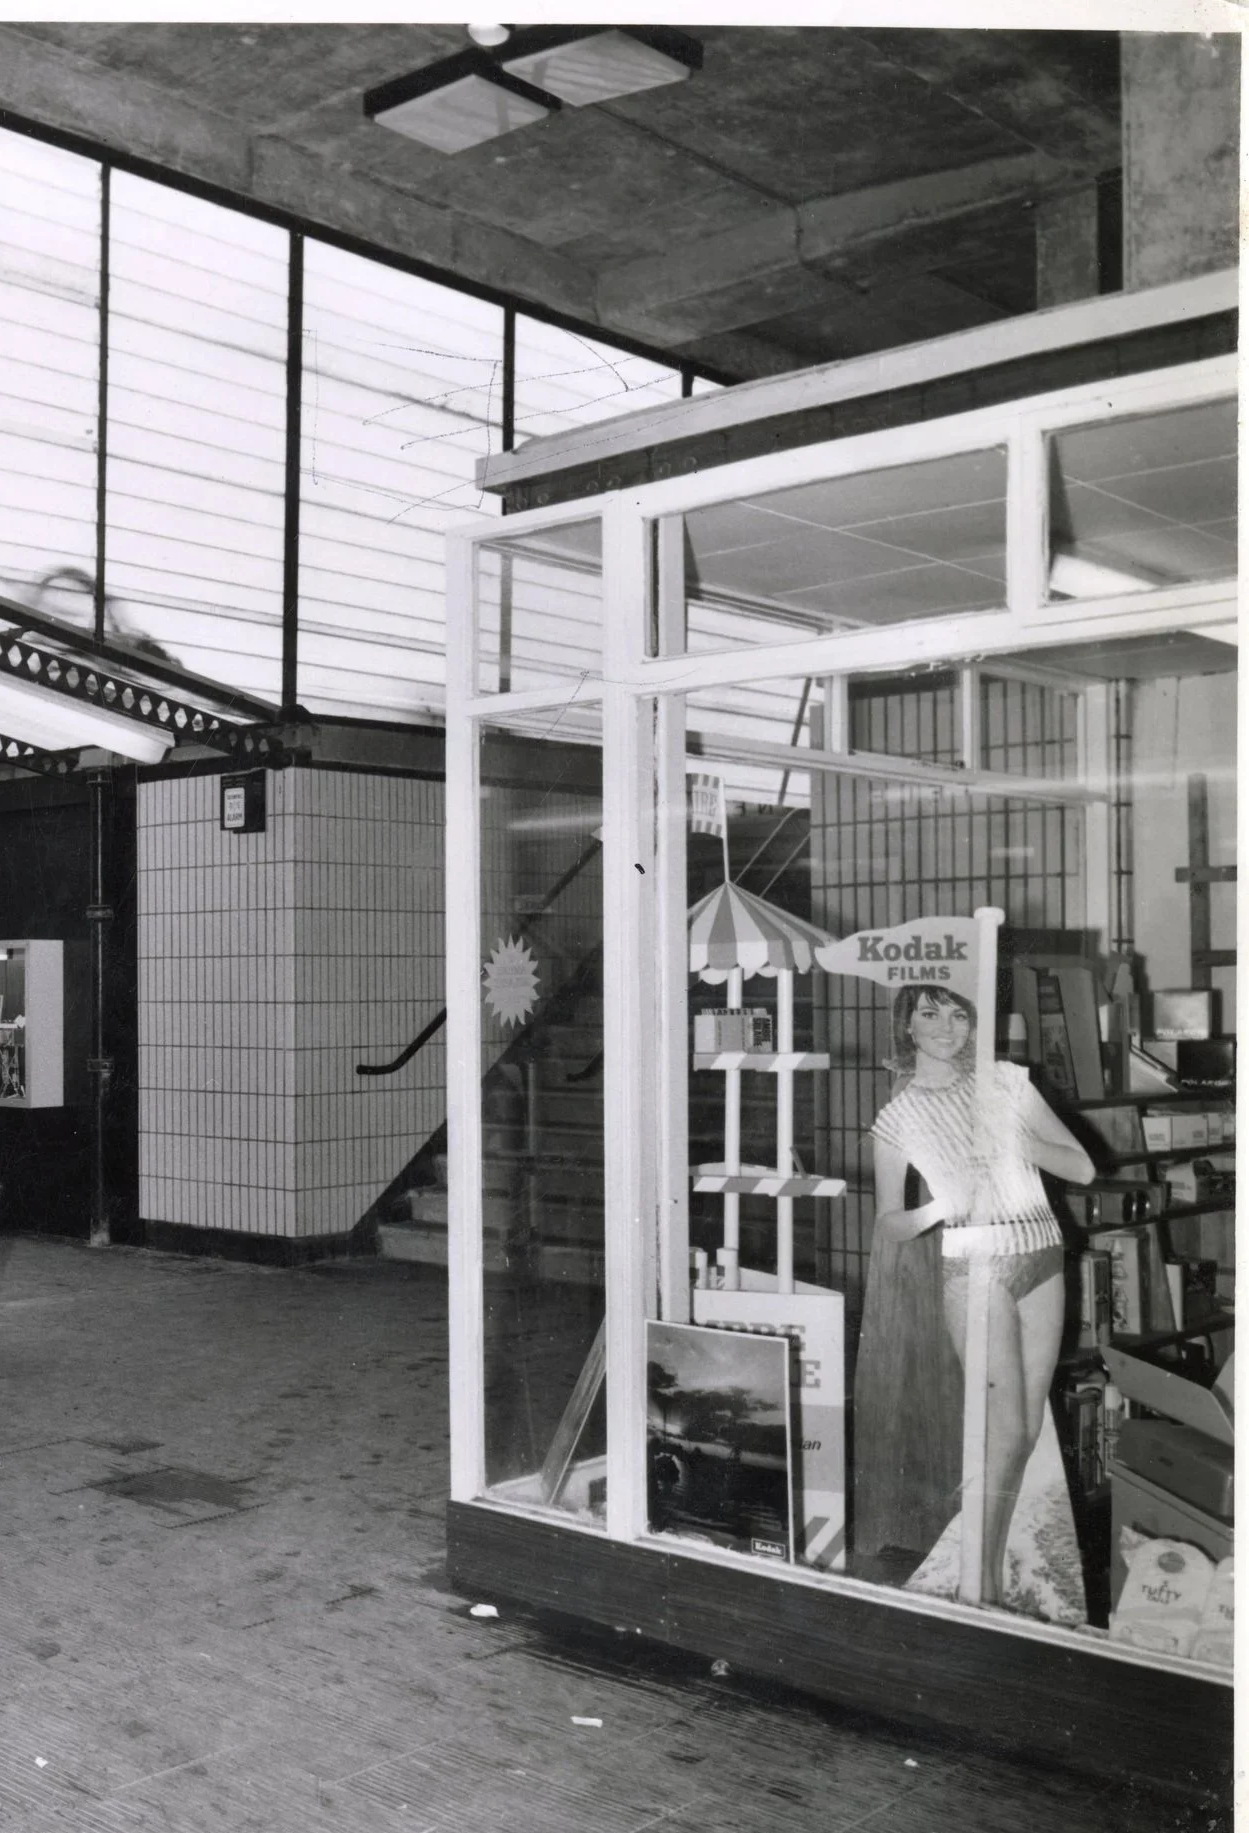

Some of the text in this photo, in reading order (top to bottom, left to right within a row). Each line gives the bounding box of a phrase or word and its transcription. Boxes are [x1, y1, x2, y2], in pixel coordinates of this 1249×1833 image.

[857, 934, 968, 962] Kodak
[887, 965, 951, 981] FILMS
[755, 1542, 782, 1555] Kodak
